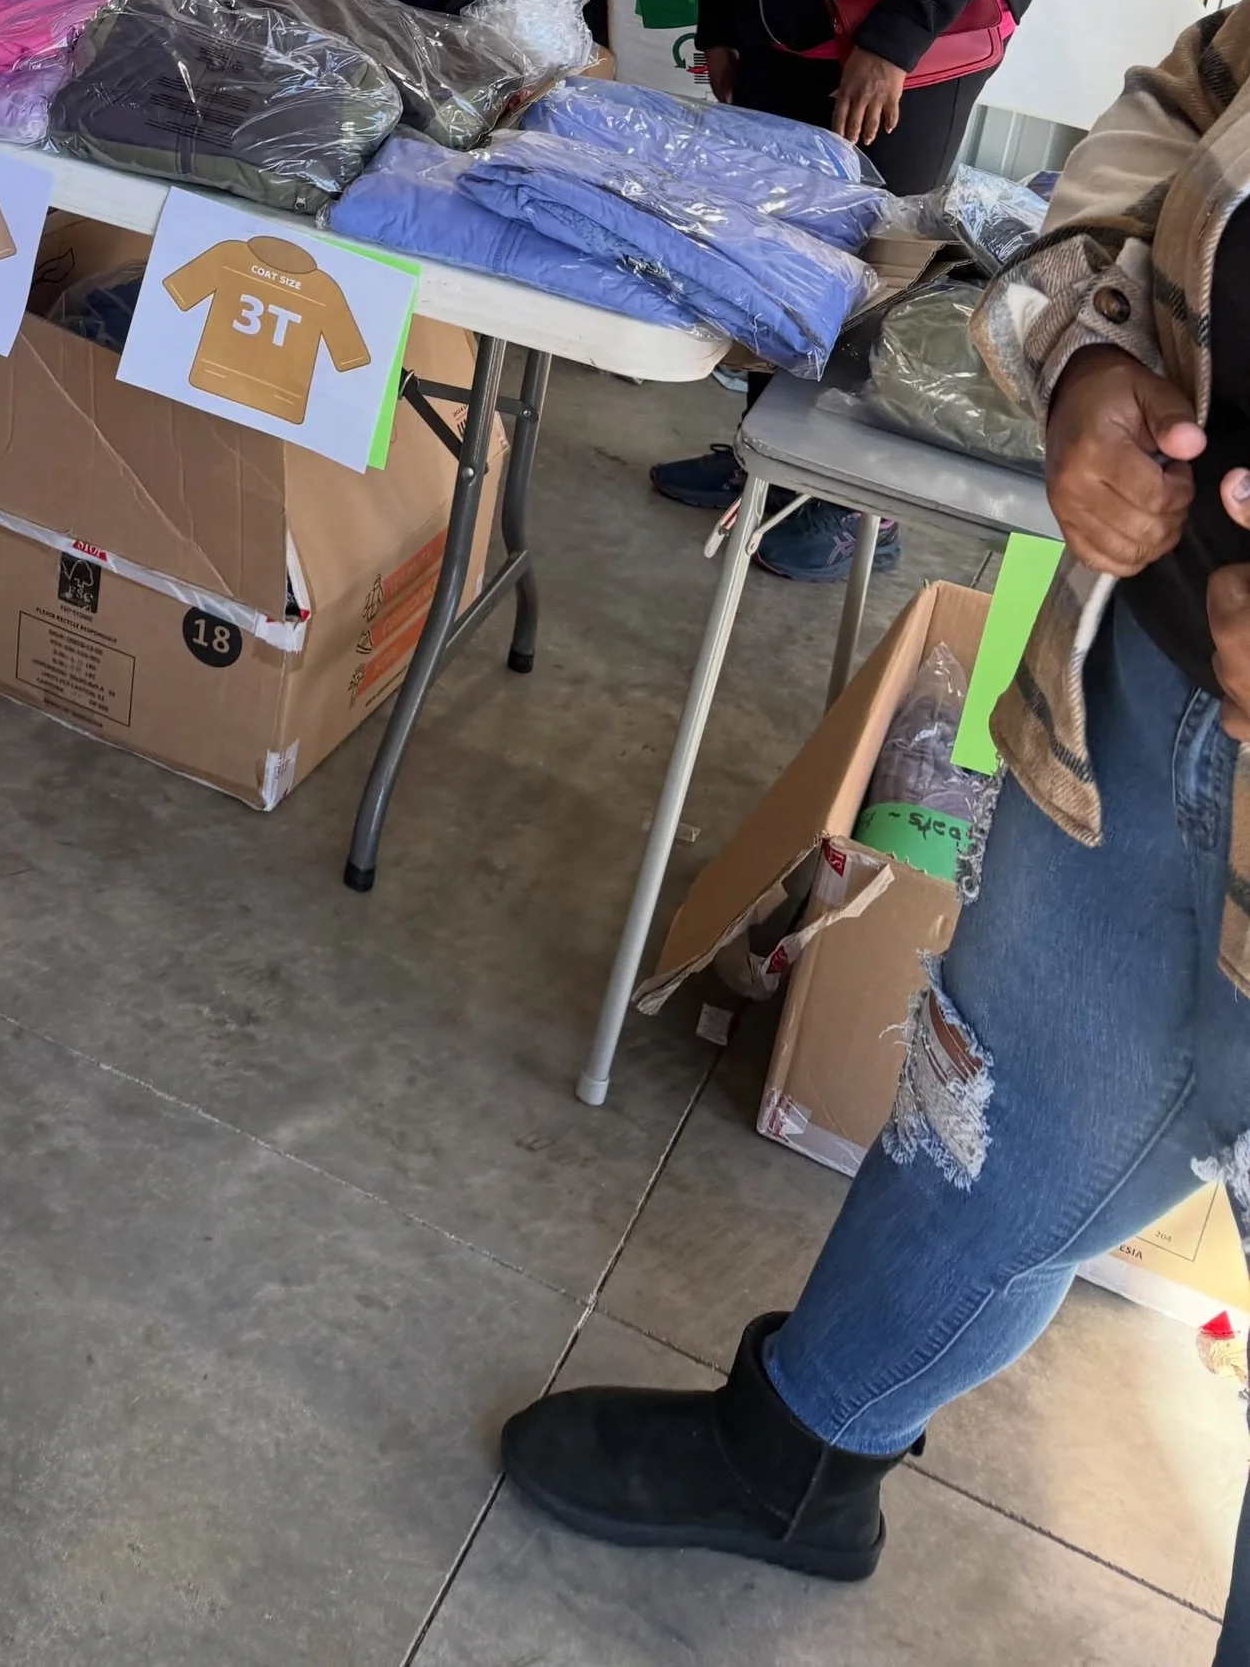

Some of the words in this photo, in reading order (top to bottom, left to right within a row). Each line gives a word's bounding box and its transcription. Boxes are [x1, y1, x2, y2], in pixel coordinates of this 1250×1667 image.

[251, 265, 278, 281] COAT
[279, 275, 302, 290] SIZE
[232, 294, 302, 348] 3T
[191, 619, 231, 654] 18
[1119, 1244, 1143, 1260] ESIA
